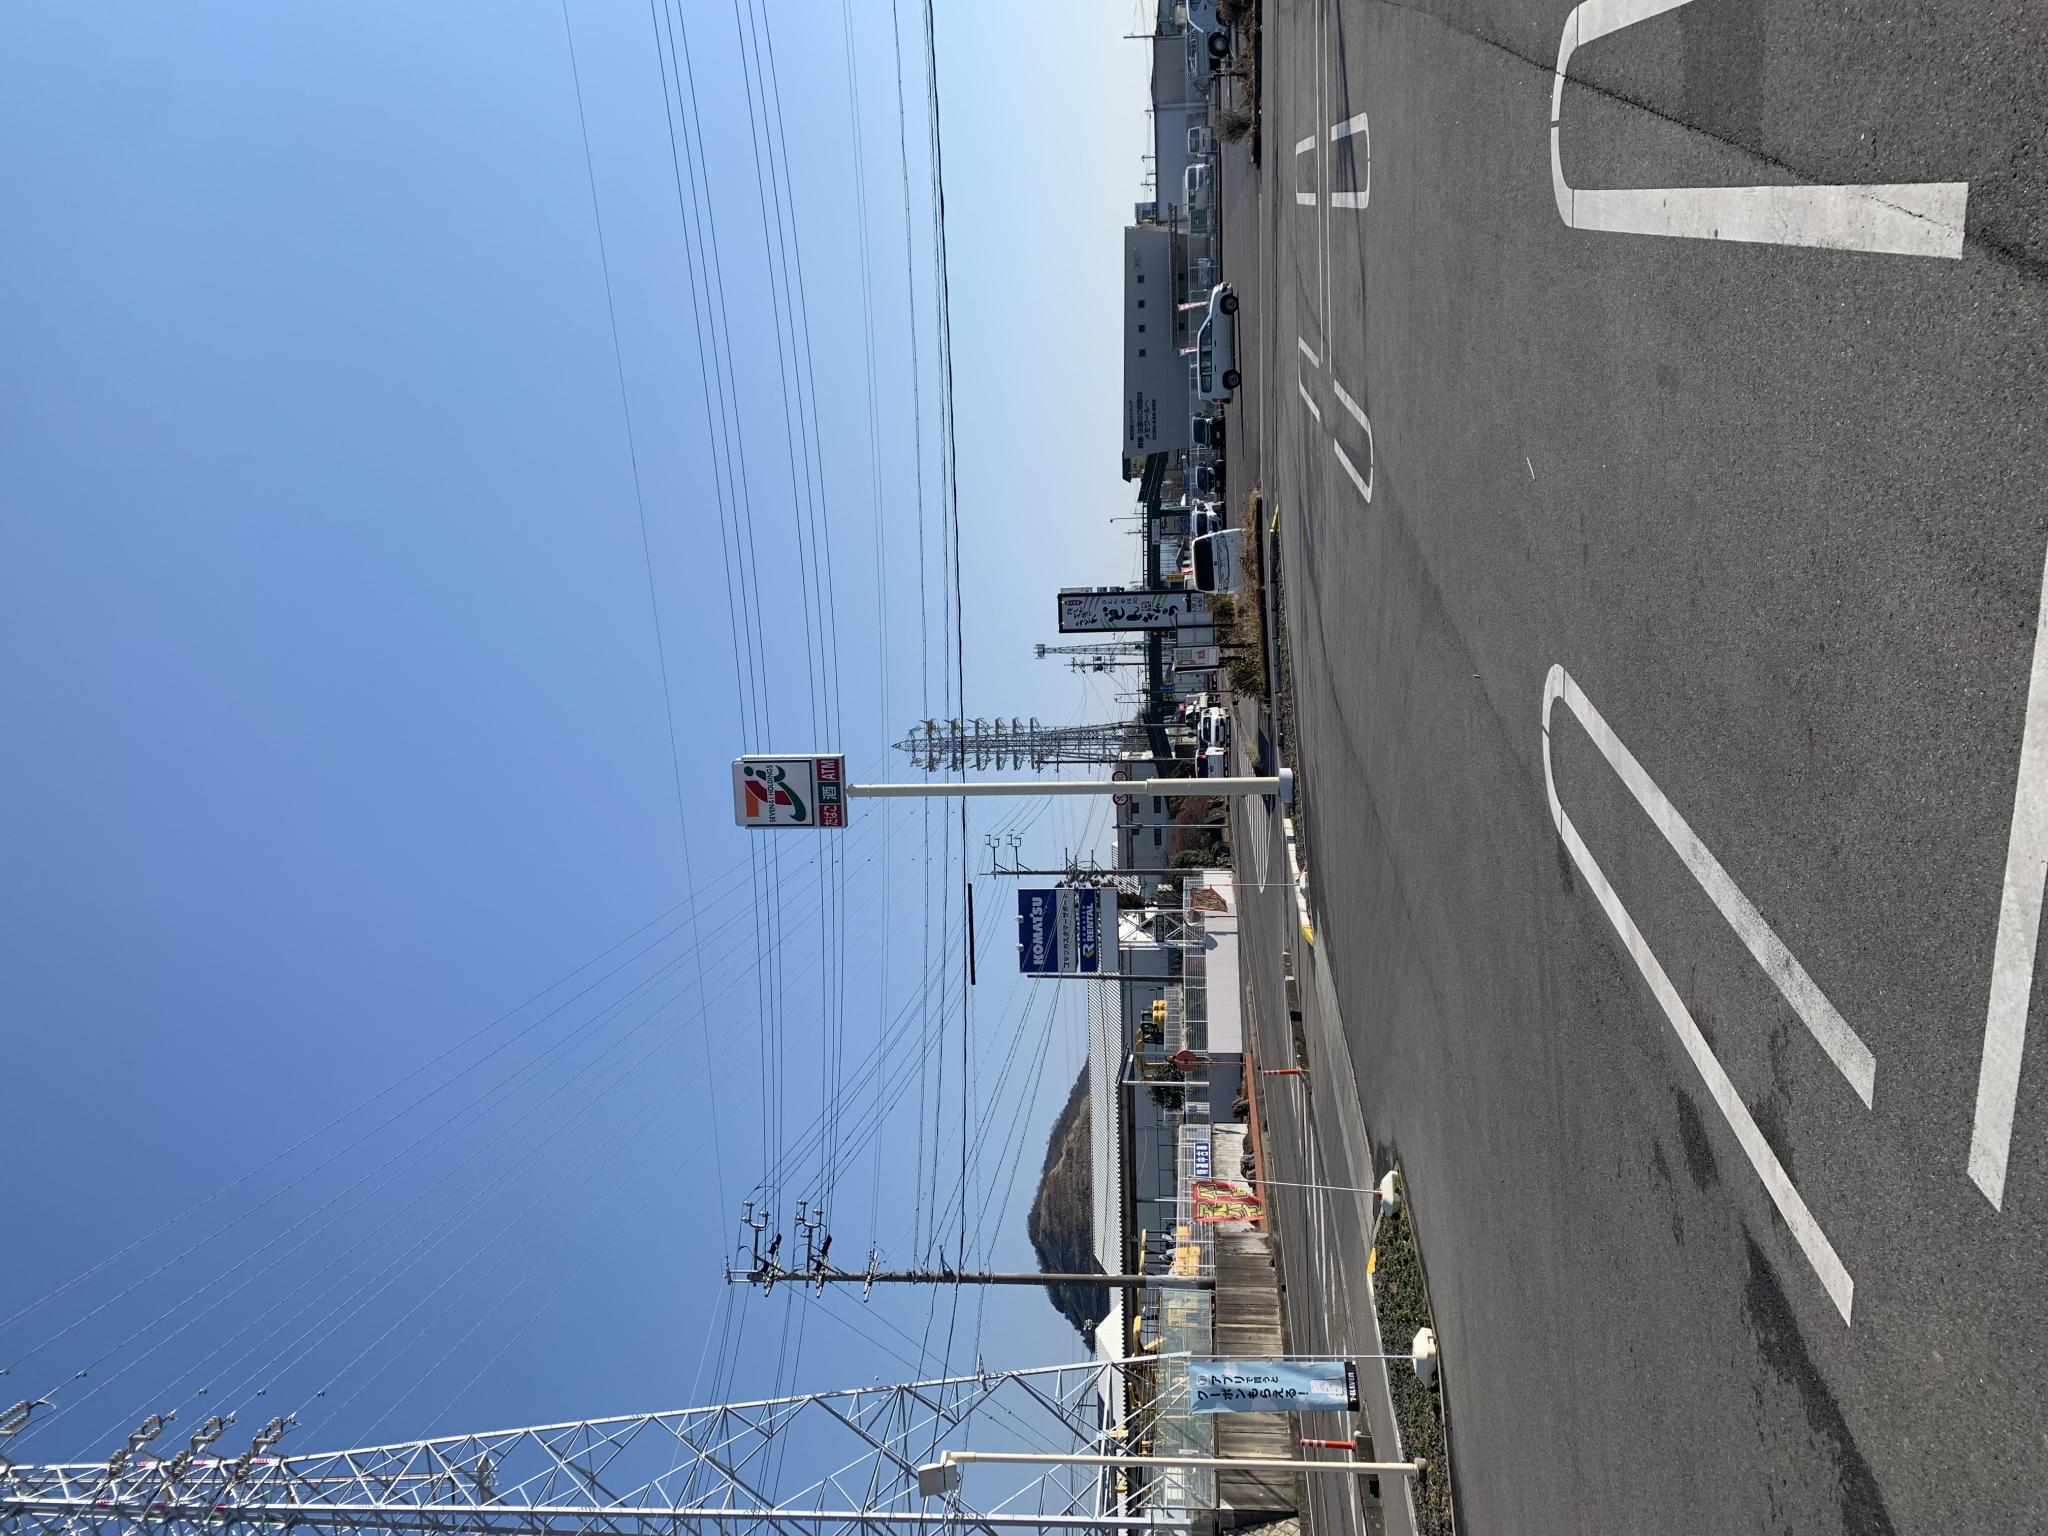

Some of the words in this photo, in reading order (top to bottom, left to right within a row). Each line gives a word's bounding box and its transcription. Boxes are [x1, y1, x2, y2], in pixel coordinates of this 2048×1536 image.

[766, 764, 775, 796] HOLDINGS
[820, 760, 836, 780] ATM
[822, 786, 837, 800] 酒
[824, 804, 838, 826] たばこ
[1030, 896, 1044, 965] KOMATSU
[1086, 903, 1094, 942] RENTAL
[1198, 1185, 1247, 1199] パート
[1211, 1375, 1279, 1386] アプリで買うと
[1197, 1387, 1309, 1401] クーポンもらえる！
